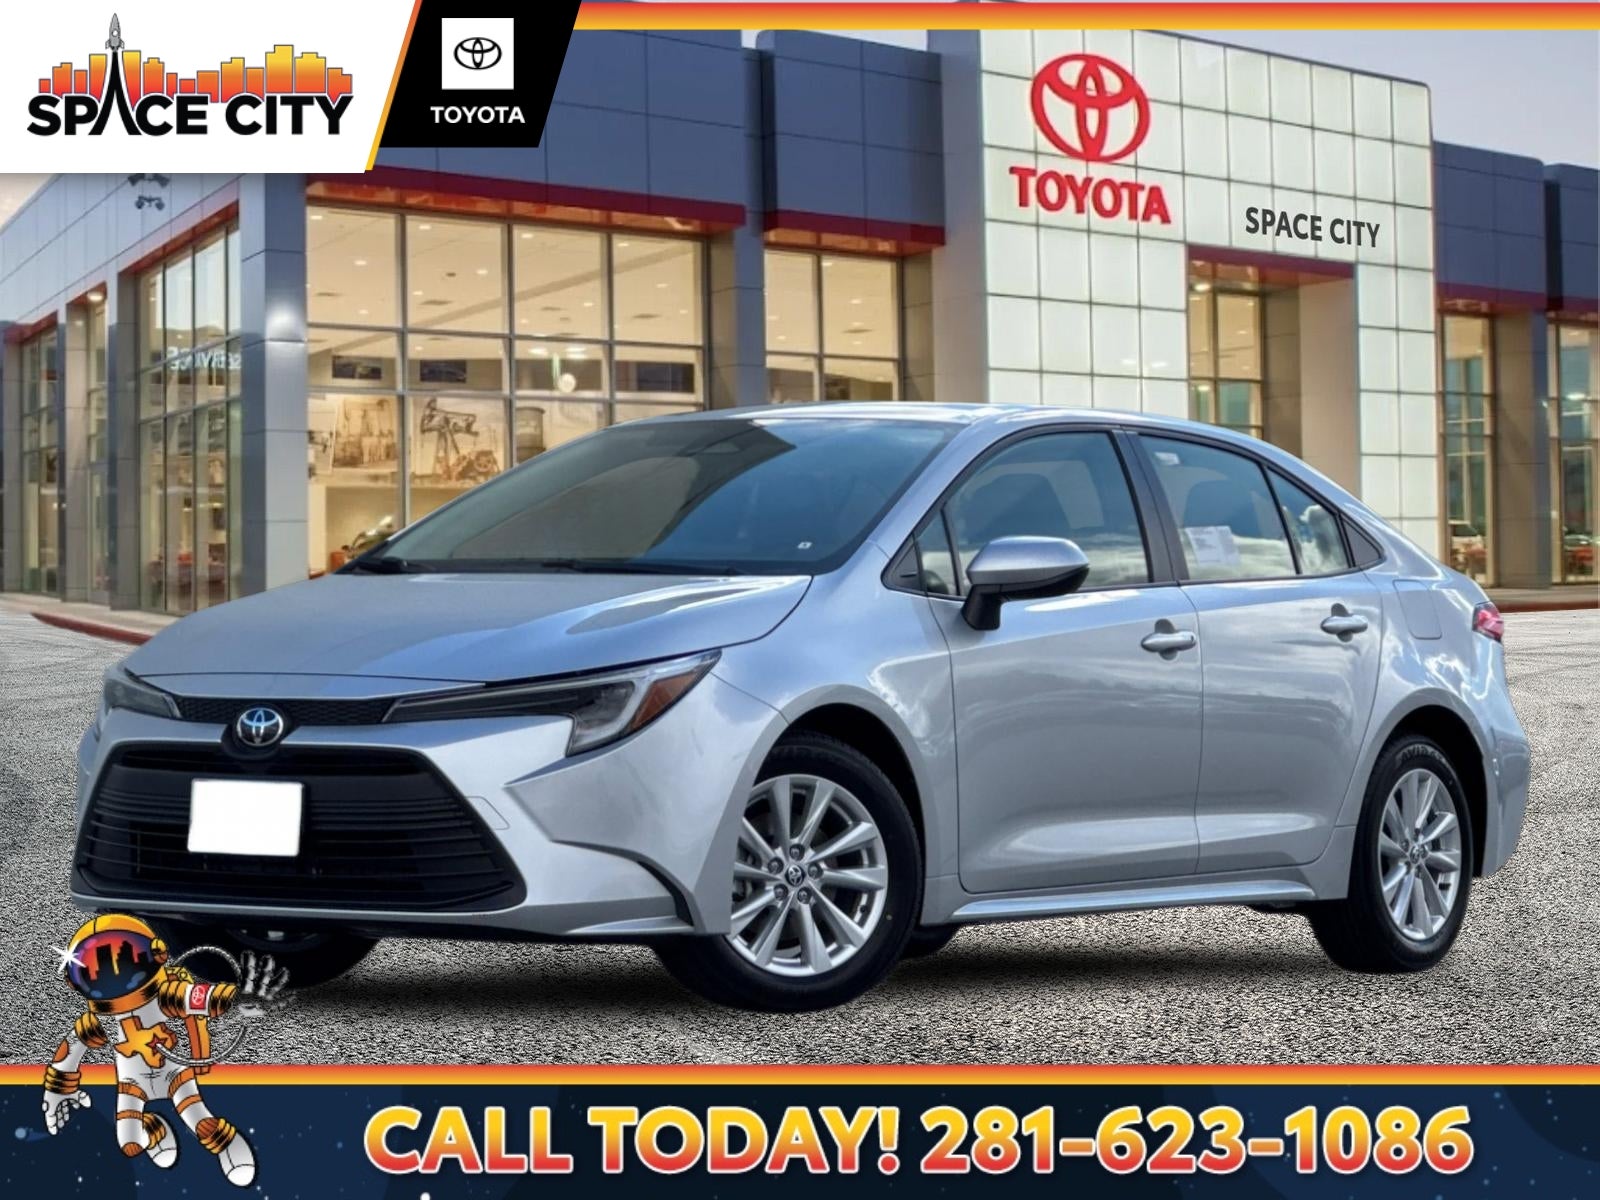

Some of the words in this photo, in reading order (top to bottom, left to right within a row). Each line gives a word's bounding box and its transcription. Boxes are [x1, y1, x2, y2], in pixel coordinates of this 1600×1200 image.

[1010, 166, 1171, 224] TOYOTA
[1245, 206, 1323, 242] SPACE
[1329, 217, 1381, 248] CITY
